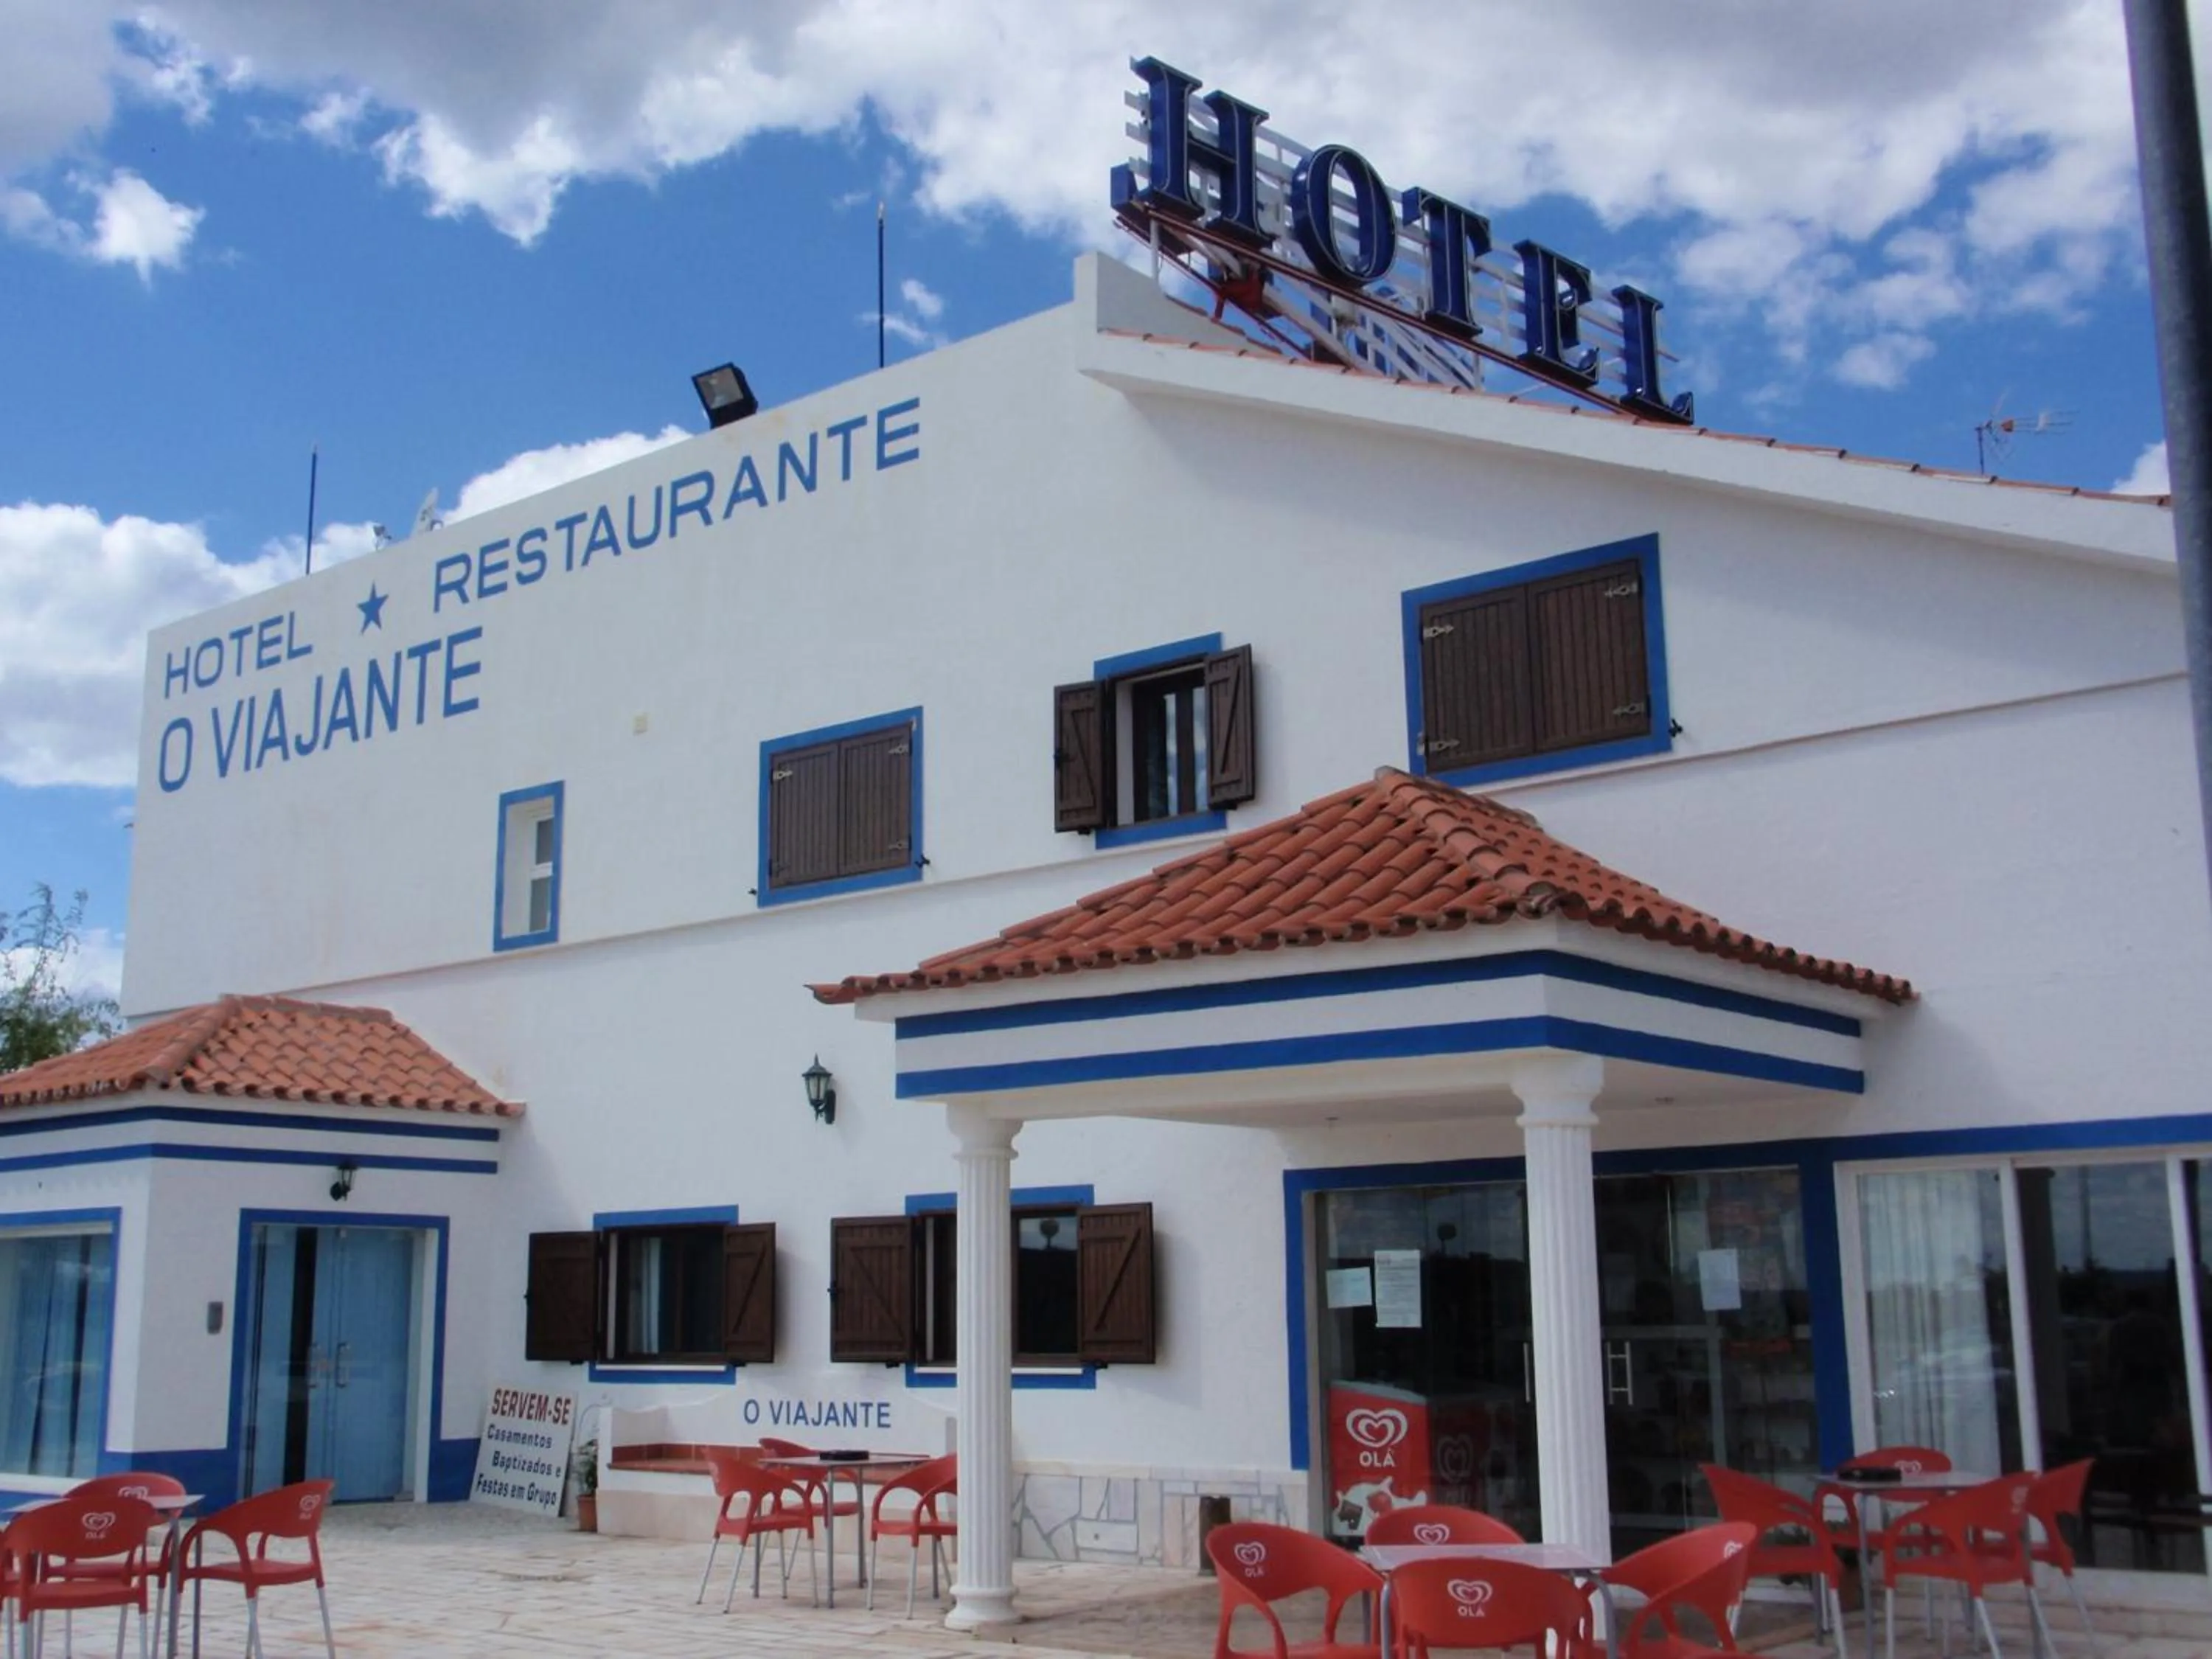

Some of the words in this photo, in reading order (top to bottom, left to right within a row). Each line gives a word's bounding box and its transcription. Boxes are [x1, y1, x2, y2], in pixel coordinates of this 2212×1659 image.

[1130, 55, 1694, 425] HOTEL
[164, 611, 313, 699] HOTEL
[432, 397, 920, 613] RESTAURANTE
[156, 716, 194, 793] O
[211, 626, 484, 779] VIAJANTE
[491, 1388, 571, 1425] SERVEM-SE
[744, 1399, 759, 1425] O
[770, 1399, 891, 1428] VIAJANTE
[487, 1424, 552, 1449] Casamentos
[492, 1450, 552, 1475] Baptizados
[476, 1472, 508, 1498] Festas
[527, 1481, 557, 1509] Grupo
